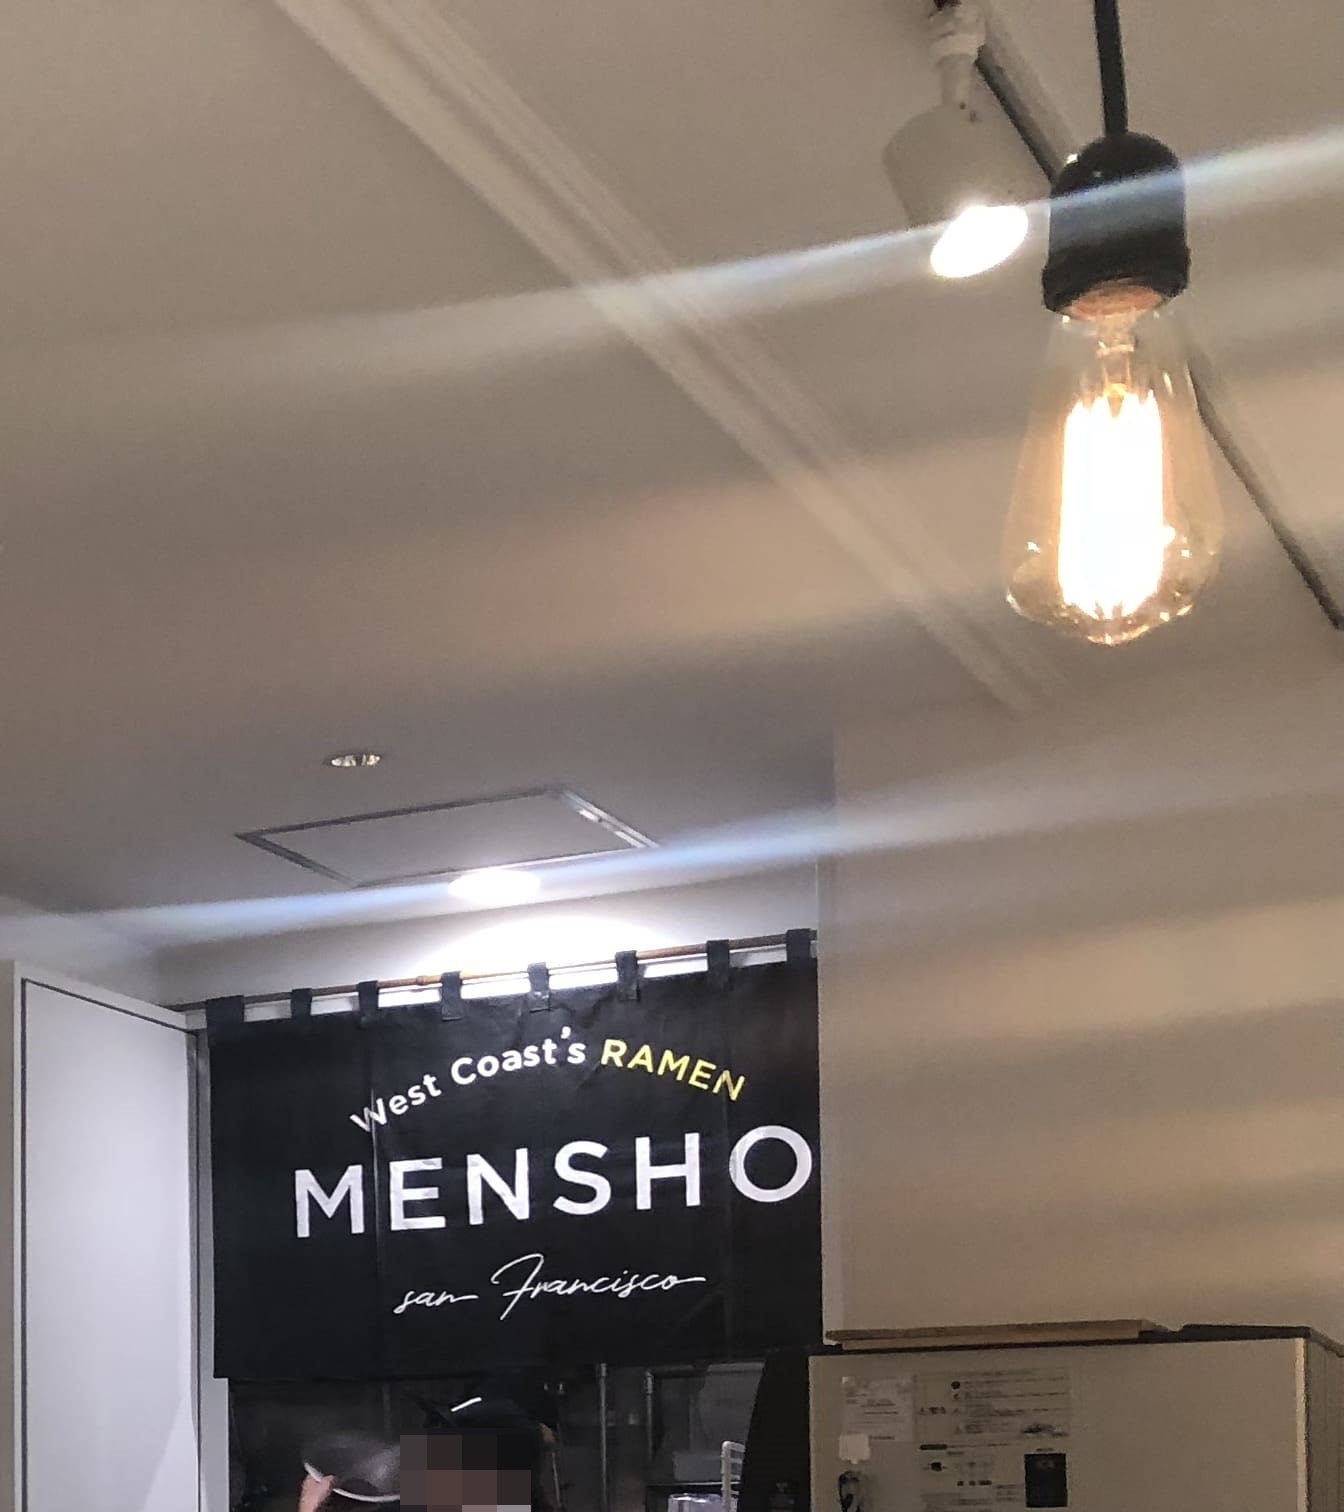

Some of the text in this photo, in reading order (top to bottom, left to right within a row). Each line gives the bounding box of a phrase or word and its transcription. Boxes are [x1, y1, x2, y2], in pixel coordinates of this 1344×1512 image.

[350, 1026, 747, 1136] West Coast's RAMEN
[294, 1124, 813, 1239] MENSHO
[394, 1253, 707, 1321] san Francisco
